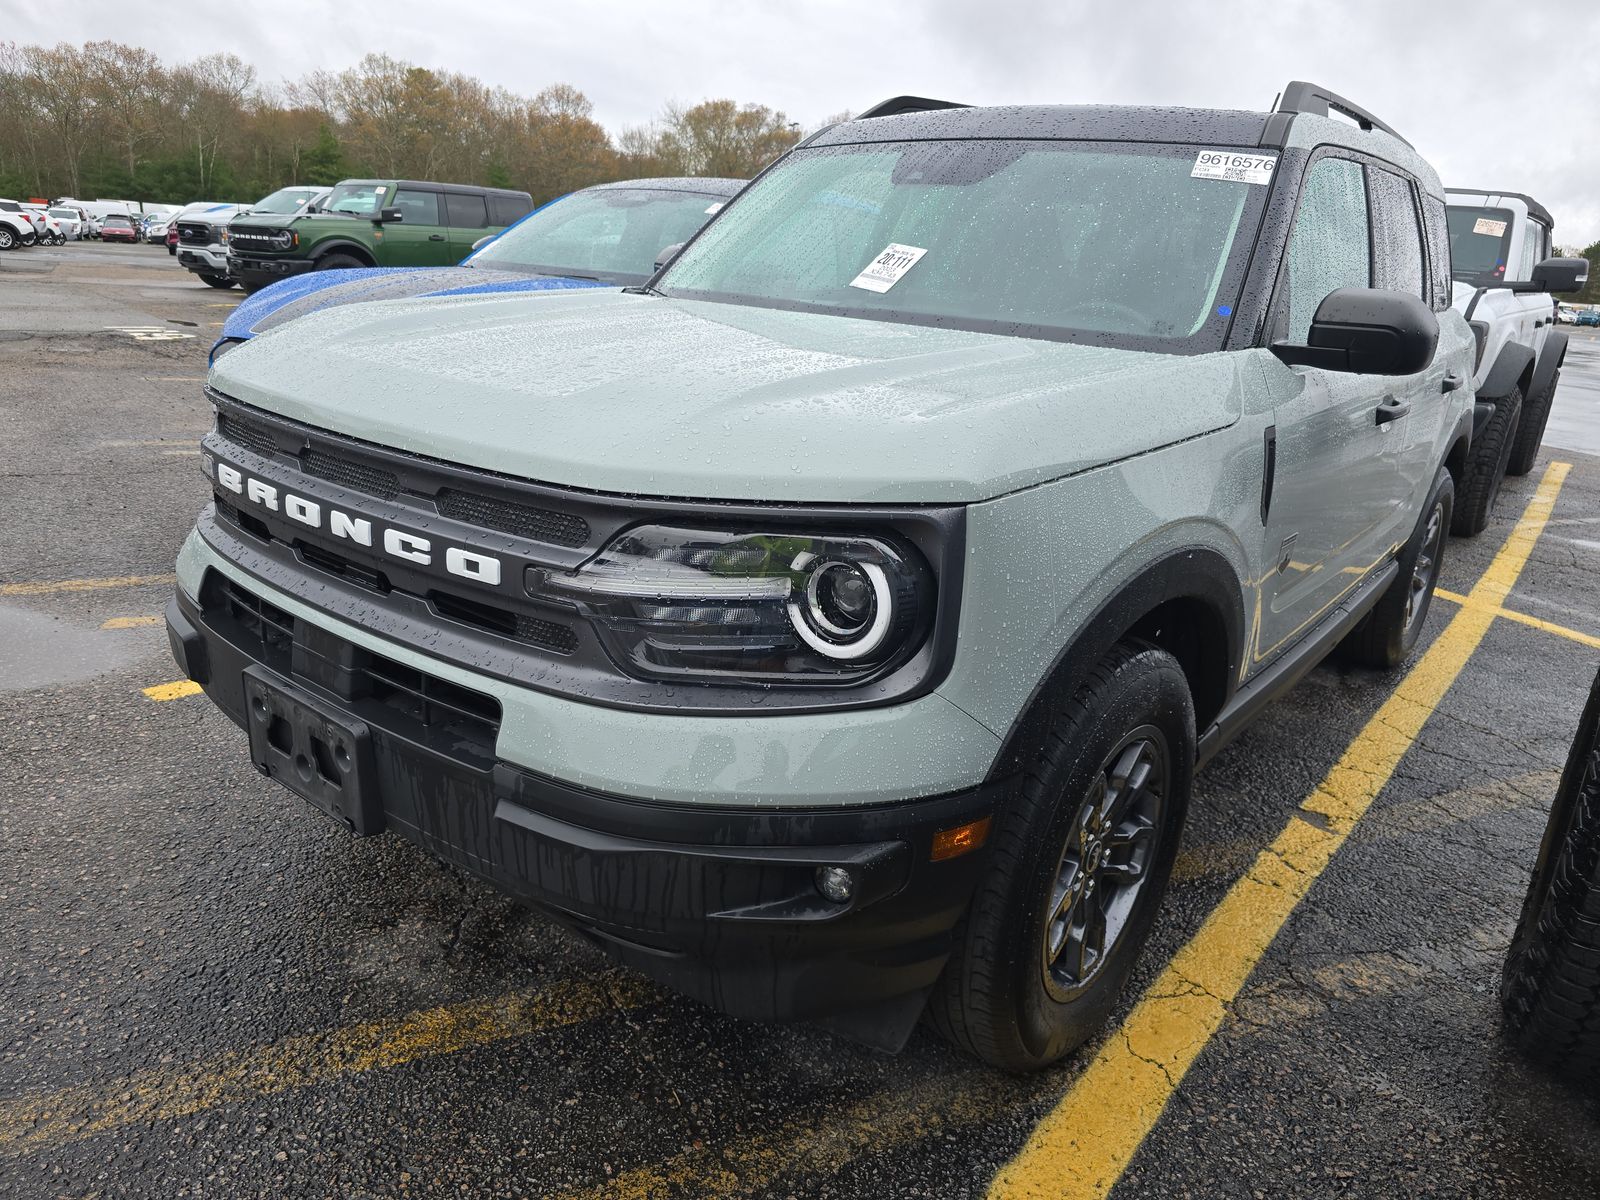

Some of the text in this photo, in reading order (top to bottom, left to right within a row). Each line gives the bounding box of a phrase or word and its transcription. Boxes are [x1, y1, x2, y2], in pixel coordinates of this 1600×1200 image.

[1199, 154, 1275, 171] 9616576
[878, 253, 913, 269] 20:111
[218, 463, 501, 586] BRONCO
